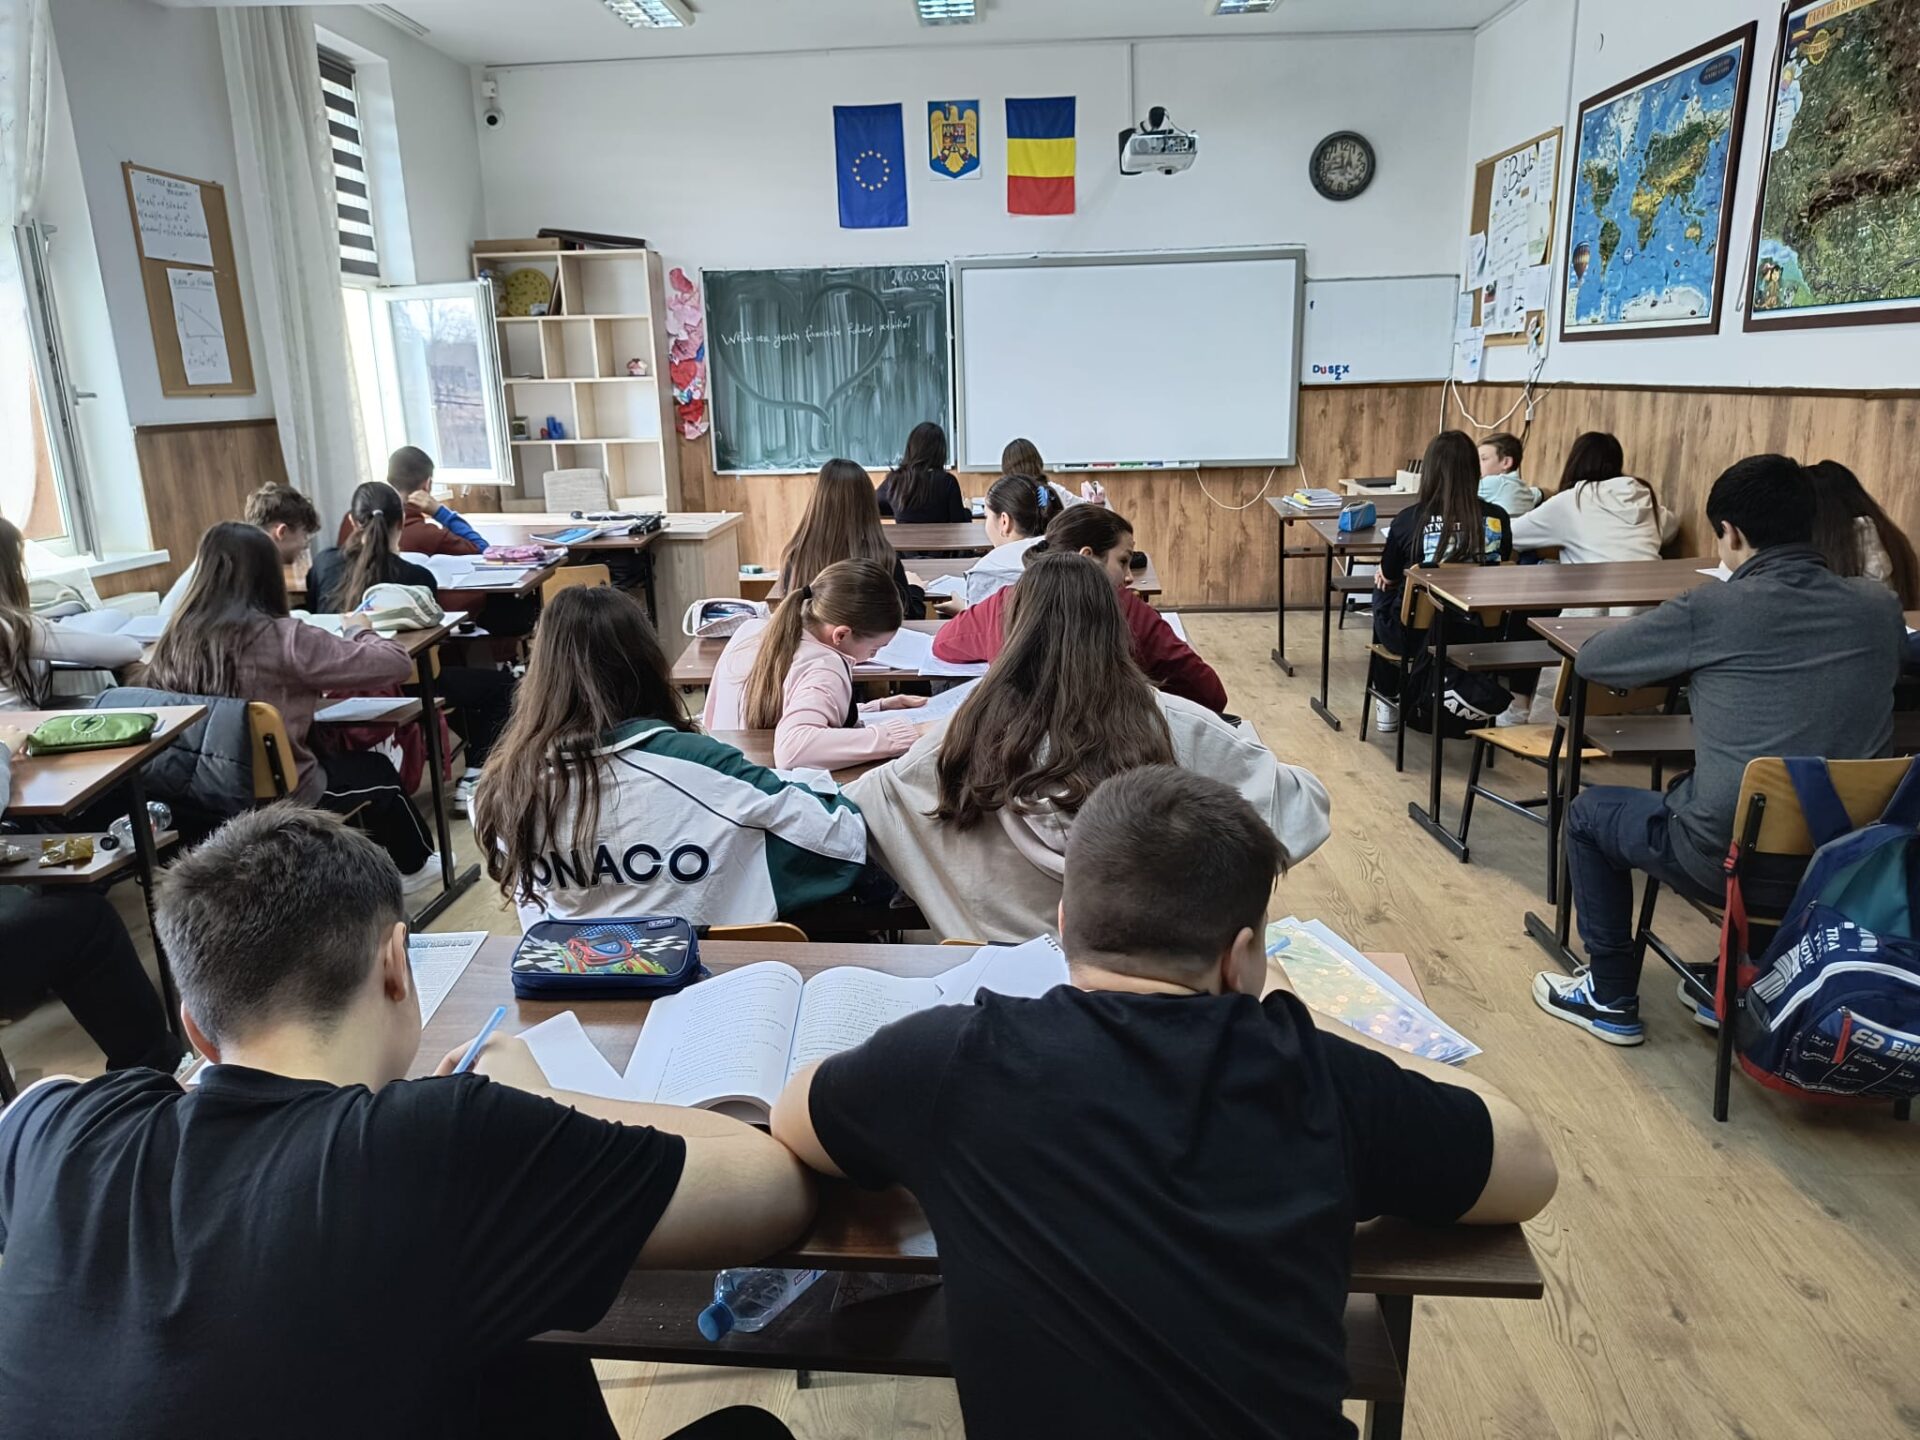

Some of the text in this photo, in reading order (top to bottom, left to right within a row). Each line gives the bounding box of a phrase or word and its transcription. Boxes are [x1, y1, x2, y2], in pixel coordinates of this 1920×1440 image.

[1340, 140, 1349, 152] 12
[1357, 152, 1364, 162] 2
[1360, 162, 1366, 173] 3
[1337, 181, 1343, 191] 6
[1347, 179, 1354, 191] 5
[773, 331, 800, 349] your
[531, 843, 711, 889] ONACO
[1885, 1049, 1920, 1063] BEN
